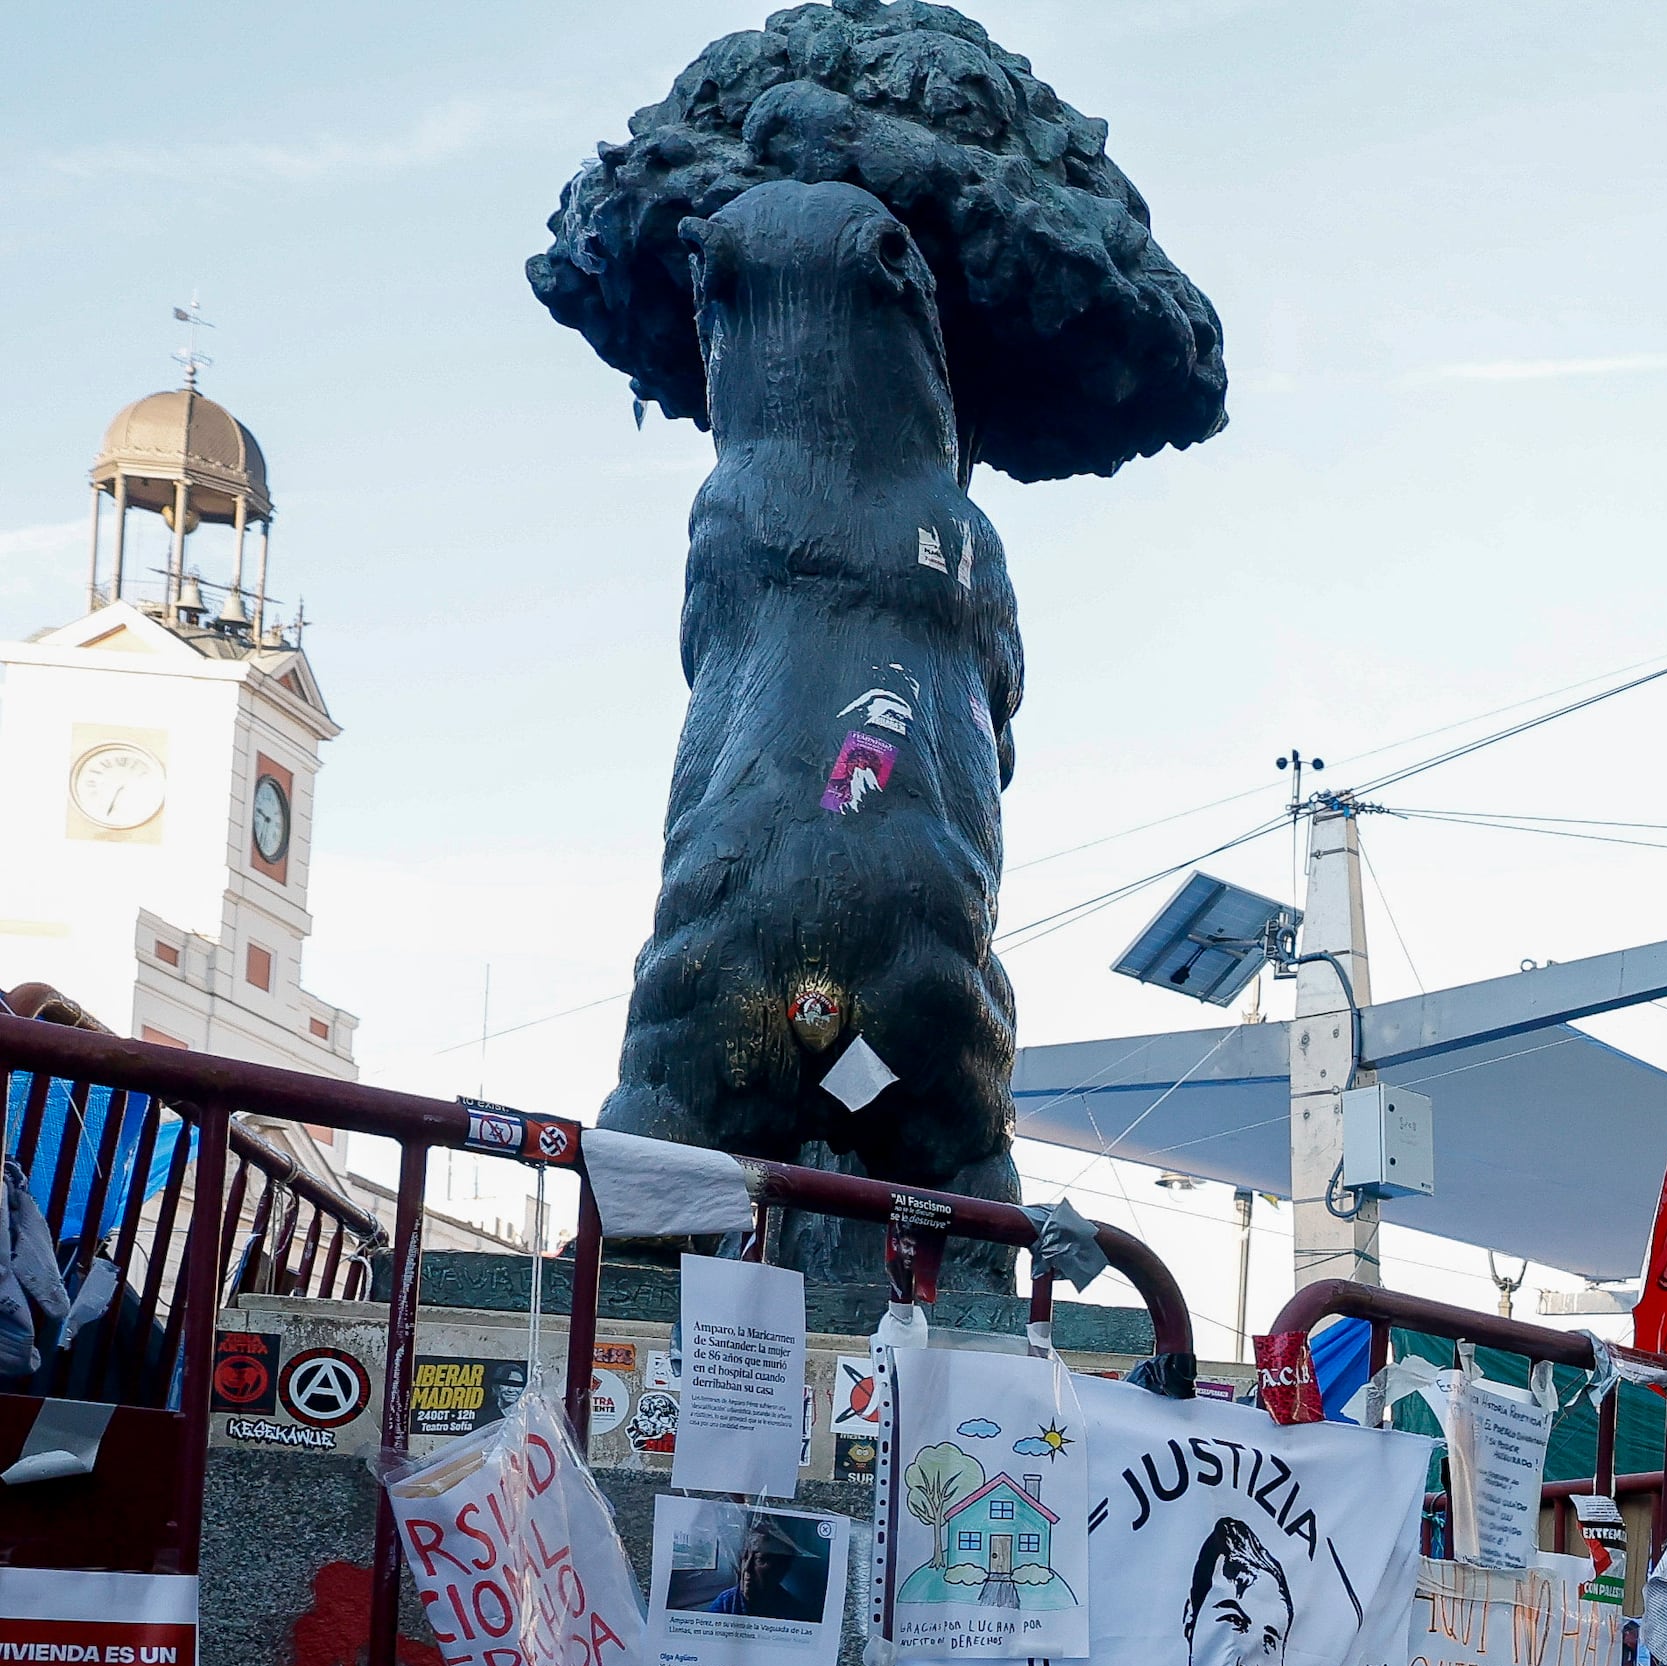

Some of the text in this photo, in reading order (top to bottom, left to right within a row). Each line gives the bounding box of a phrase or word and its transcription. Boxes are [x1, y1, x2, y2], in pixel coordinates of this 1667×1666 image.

[694, 1321, 795, 1344] Amparo, Maricarmen
[694, 1336, 791, 1358] de Santander: mujer
[694, 1349, 787, 1370] de 86 años que murió
[718, 1366, 753, 1379] hospital
[693, 1377, 742, 1391] derribaban
[411, 1387, 484, 1410] MADRID
[421, 1422, 449, 1433] Teatro
[848, 1472, 874, 1484] SUR
[1122, 1437, 1318, 1562] JUSTIZIA
[105, 1646, 177, 1664] ES UN
